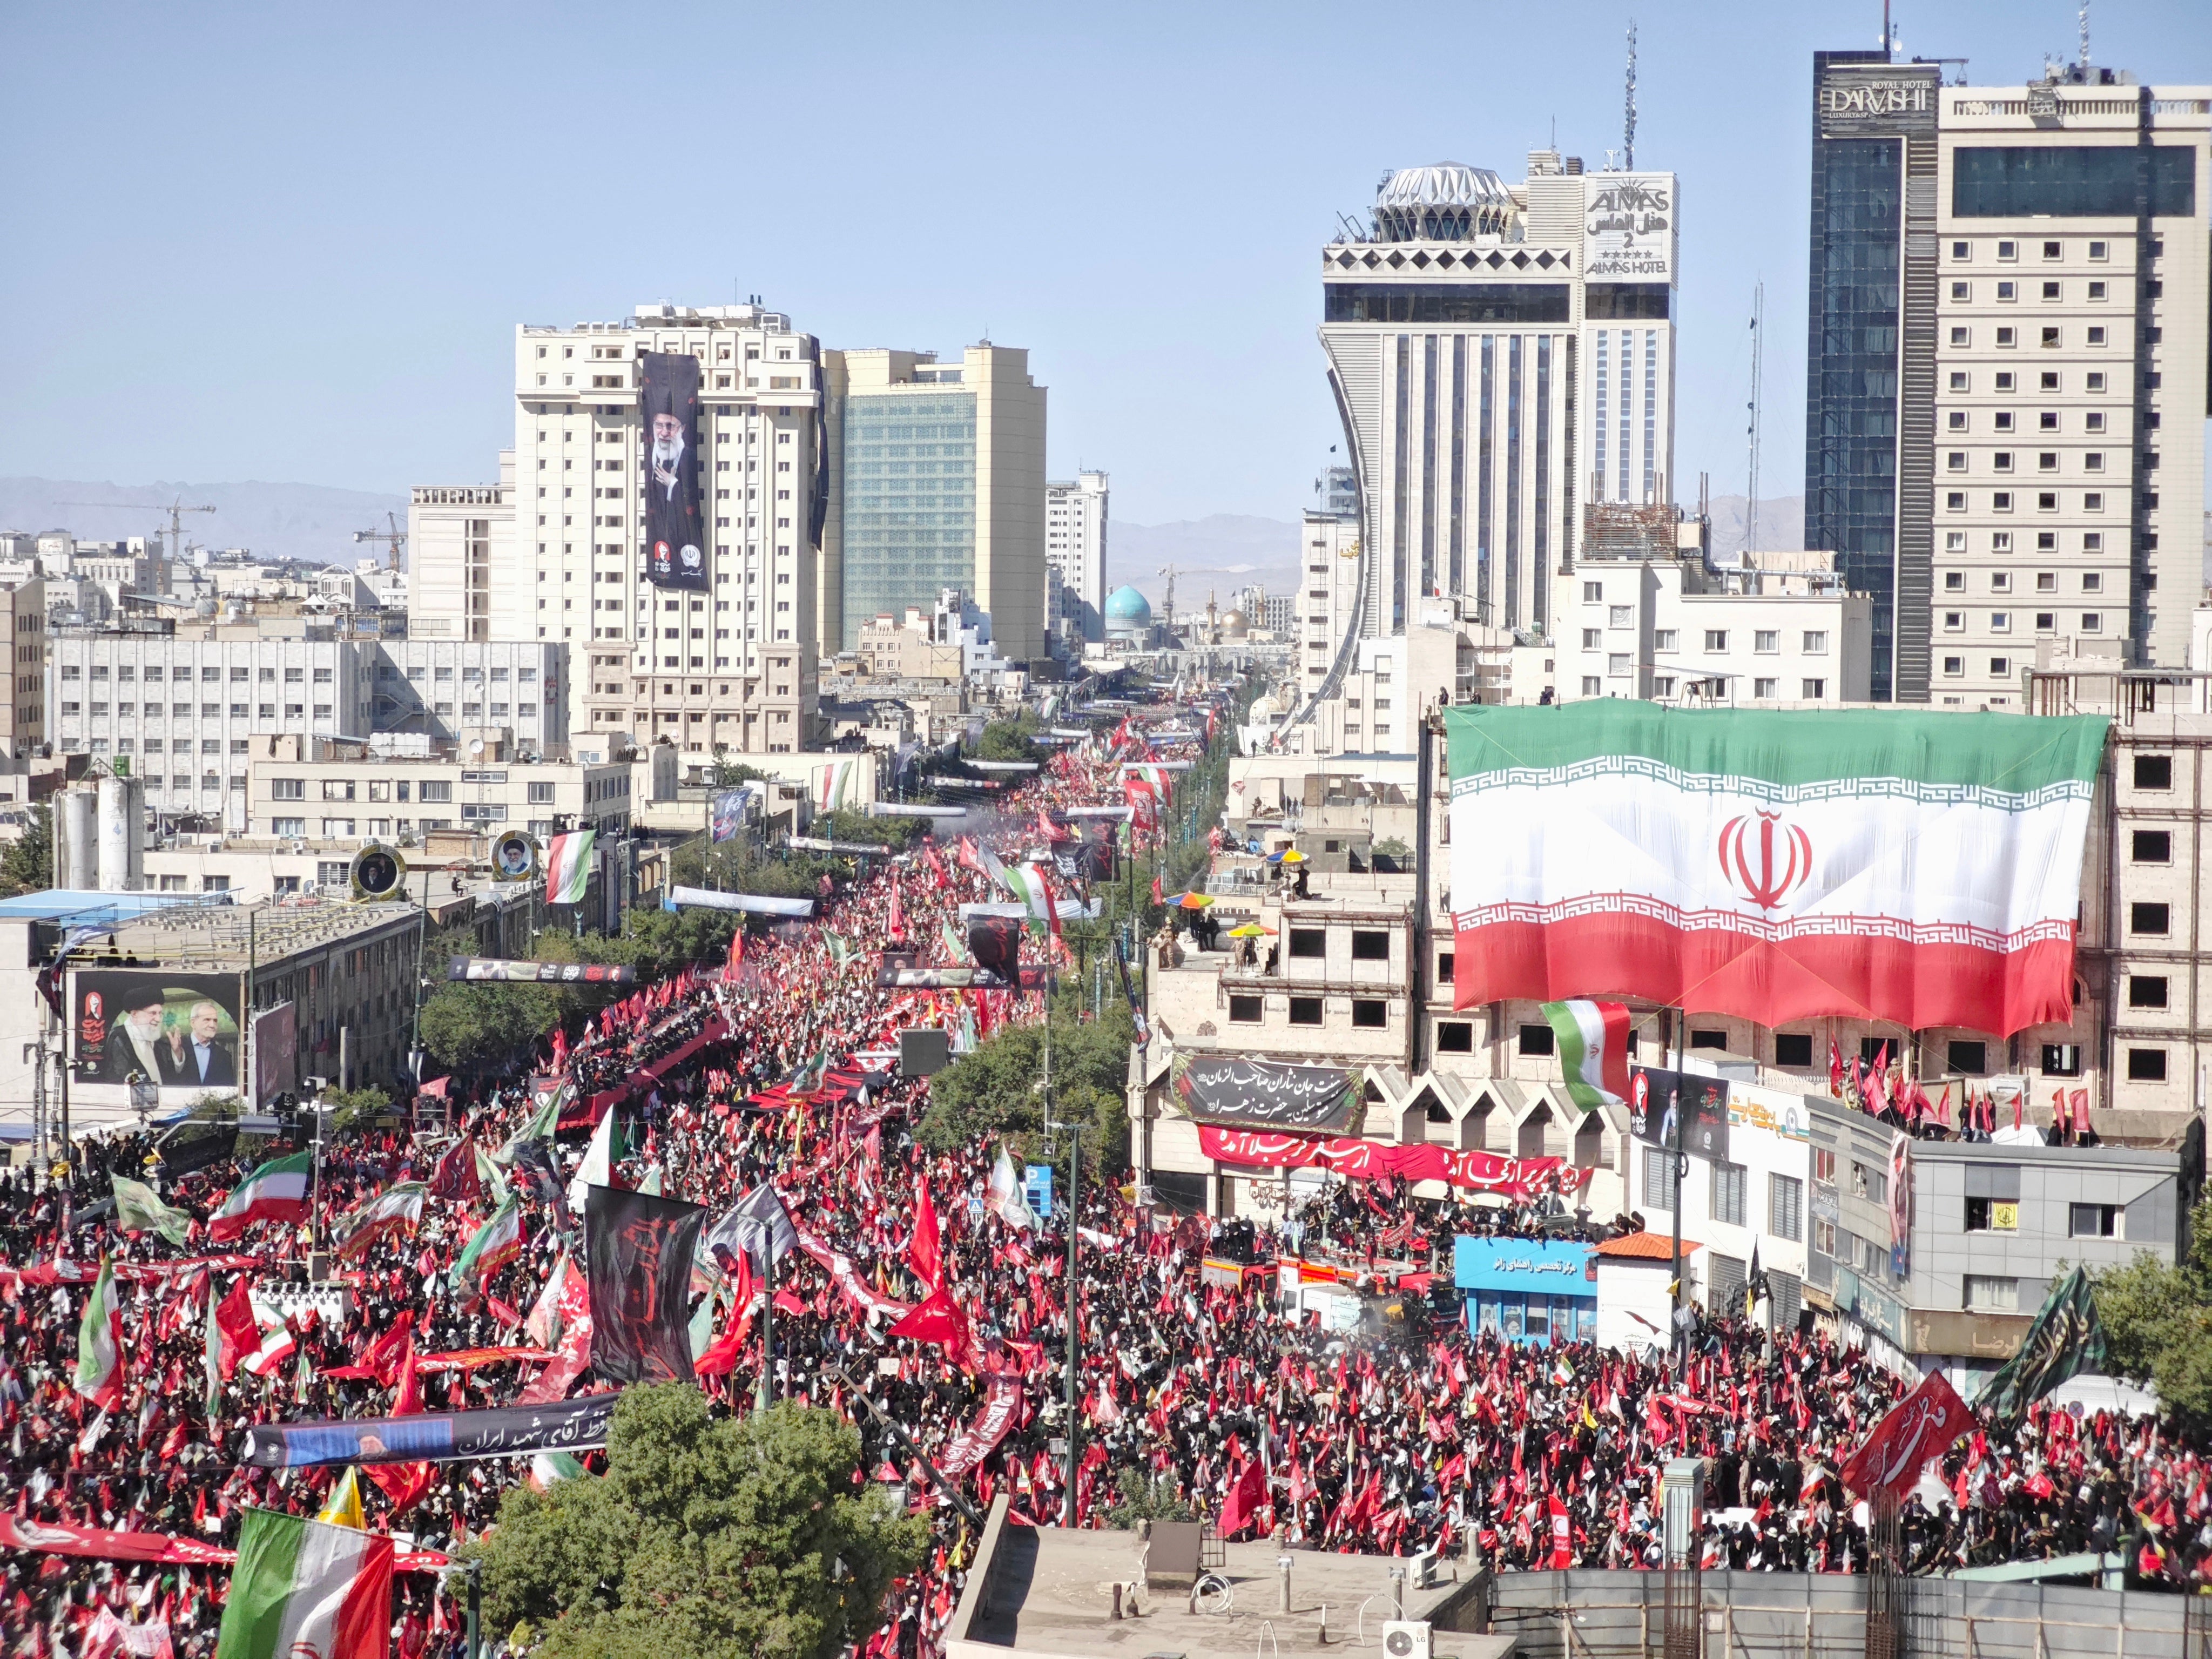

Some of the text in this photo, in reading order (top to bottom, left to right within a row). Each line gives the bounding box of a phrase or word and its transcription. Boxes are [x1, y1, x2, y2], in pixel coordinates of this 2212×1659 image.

[1872, 80, 1932, 89] ROYAL HOTEL
[1831, 86, 1926, 114] DARVISHI
[1587, 191, 1669, 212] ALMAS
[1587, 211, 1668, 235] هتل الماس
[1623, 232, 1634, 248] 2
[1586, 261, 1667, 274] ALMAS HOTEL
[1206, 1066, 1234, 1086] الزمان
[1234, 1073, 1269, 1091] صاحب
[1293, 1078, 1313, 1097] جان
[1216, 1097, 1256, 1114] زهرا
[1254, 1097, 1288, 1119] حضرت
[1027, 1169, 1038, 1184] P
[1507, 1259, 1534, 1273] راهنمای
[1535, 1260, 1563, 1273] تخصصی
[1563, 1262, 1577, 1275] مرکز
[1972, 1332, 2020, 1357] الرضا
[458, 1427, 504, 1455] ایران
